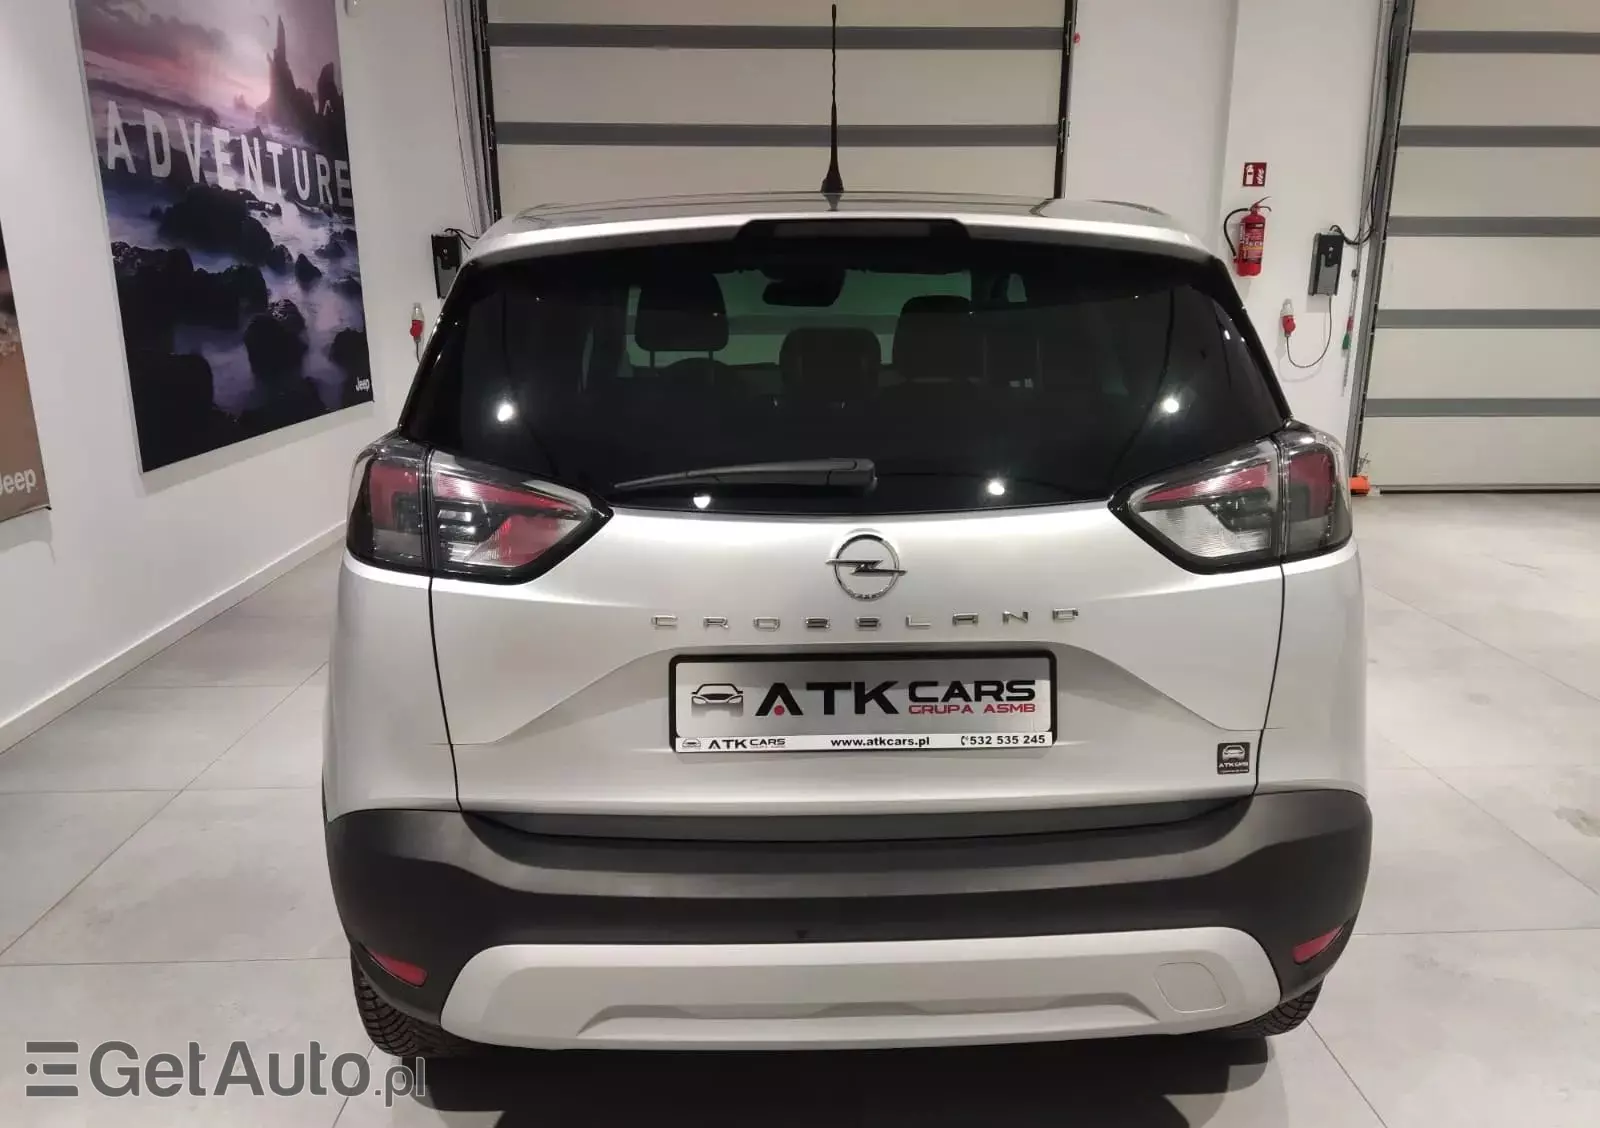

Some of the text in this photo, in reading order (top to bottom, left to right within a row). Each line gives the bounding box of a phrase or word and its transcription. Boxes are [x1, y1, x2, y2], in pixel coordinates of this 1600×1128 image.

[107, 100, 353, 208] ADVENTURE
[355, 376, 370, 392] Jeep
[651, 606, 1080, 631] CROSSLAND
[755, 679, 1036, 717] ATK CARS
[908, 703, 1036, 715] GRUPA ASMB
[708, 734, 1046, 750] ATK CARS www.atkcars.pl 532 535 245
